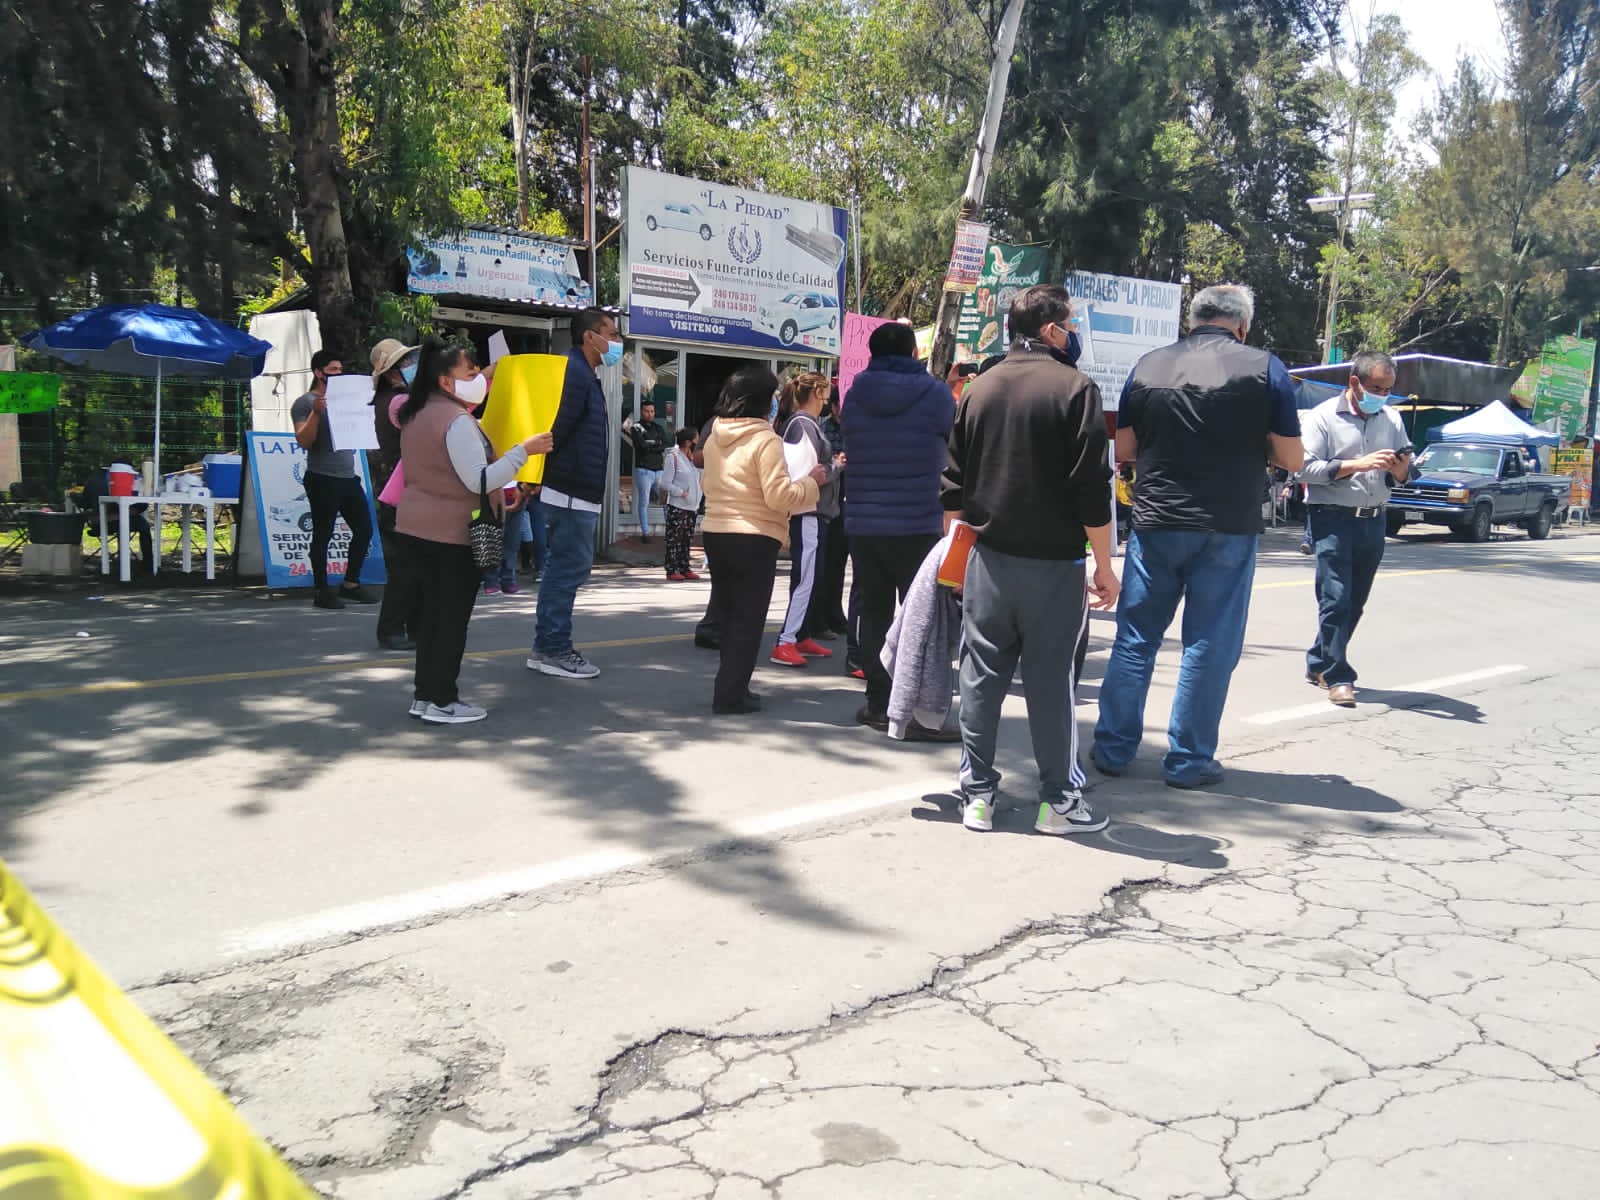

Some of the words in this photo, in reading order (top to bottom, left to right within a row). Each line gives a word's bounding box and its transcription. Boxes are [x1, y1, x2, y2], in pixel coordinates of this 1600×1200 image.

[479, 245, 544, 264] Almohadillas,
[643, 249, 704, 270] Servicios
[706, 258, 776, 281] Funerarios
[776, 269, 790, 282] de
[792, 271, 834, 289] Calidad
[1064, 273, 1119, 303] FUNERALES
[643, 307, 653, 317] No
[655, 309, 674, 320] tome
[675, 311, 710, 323] decisiones
[669, 319, 726, 335] VISITENOS
[260, 441, 283, 454] LA
[284, 551, 304, 560] DE
[289, 563, 307, 576] 24
